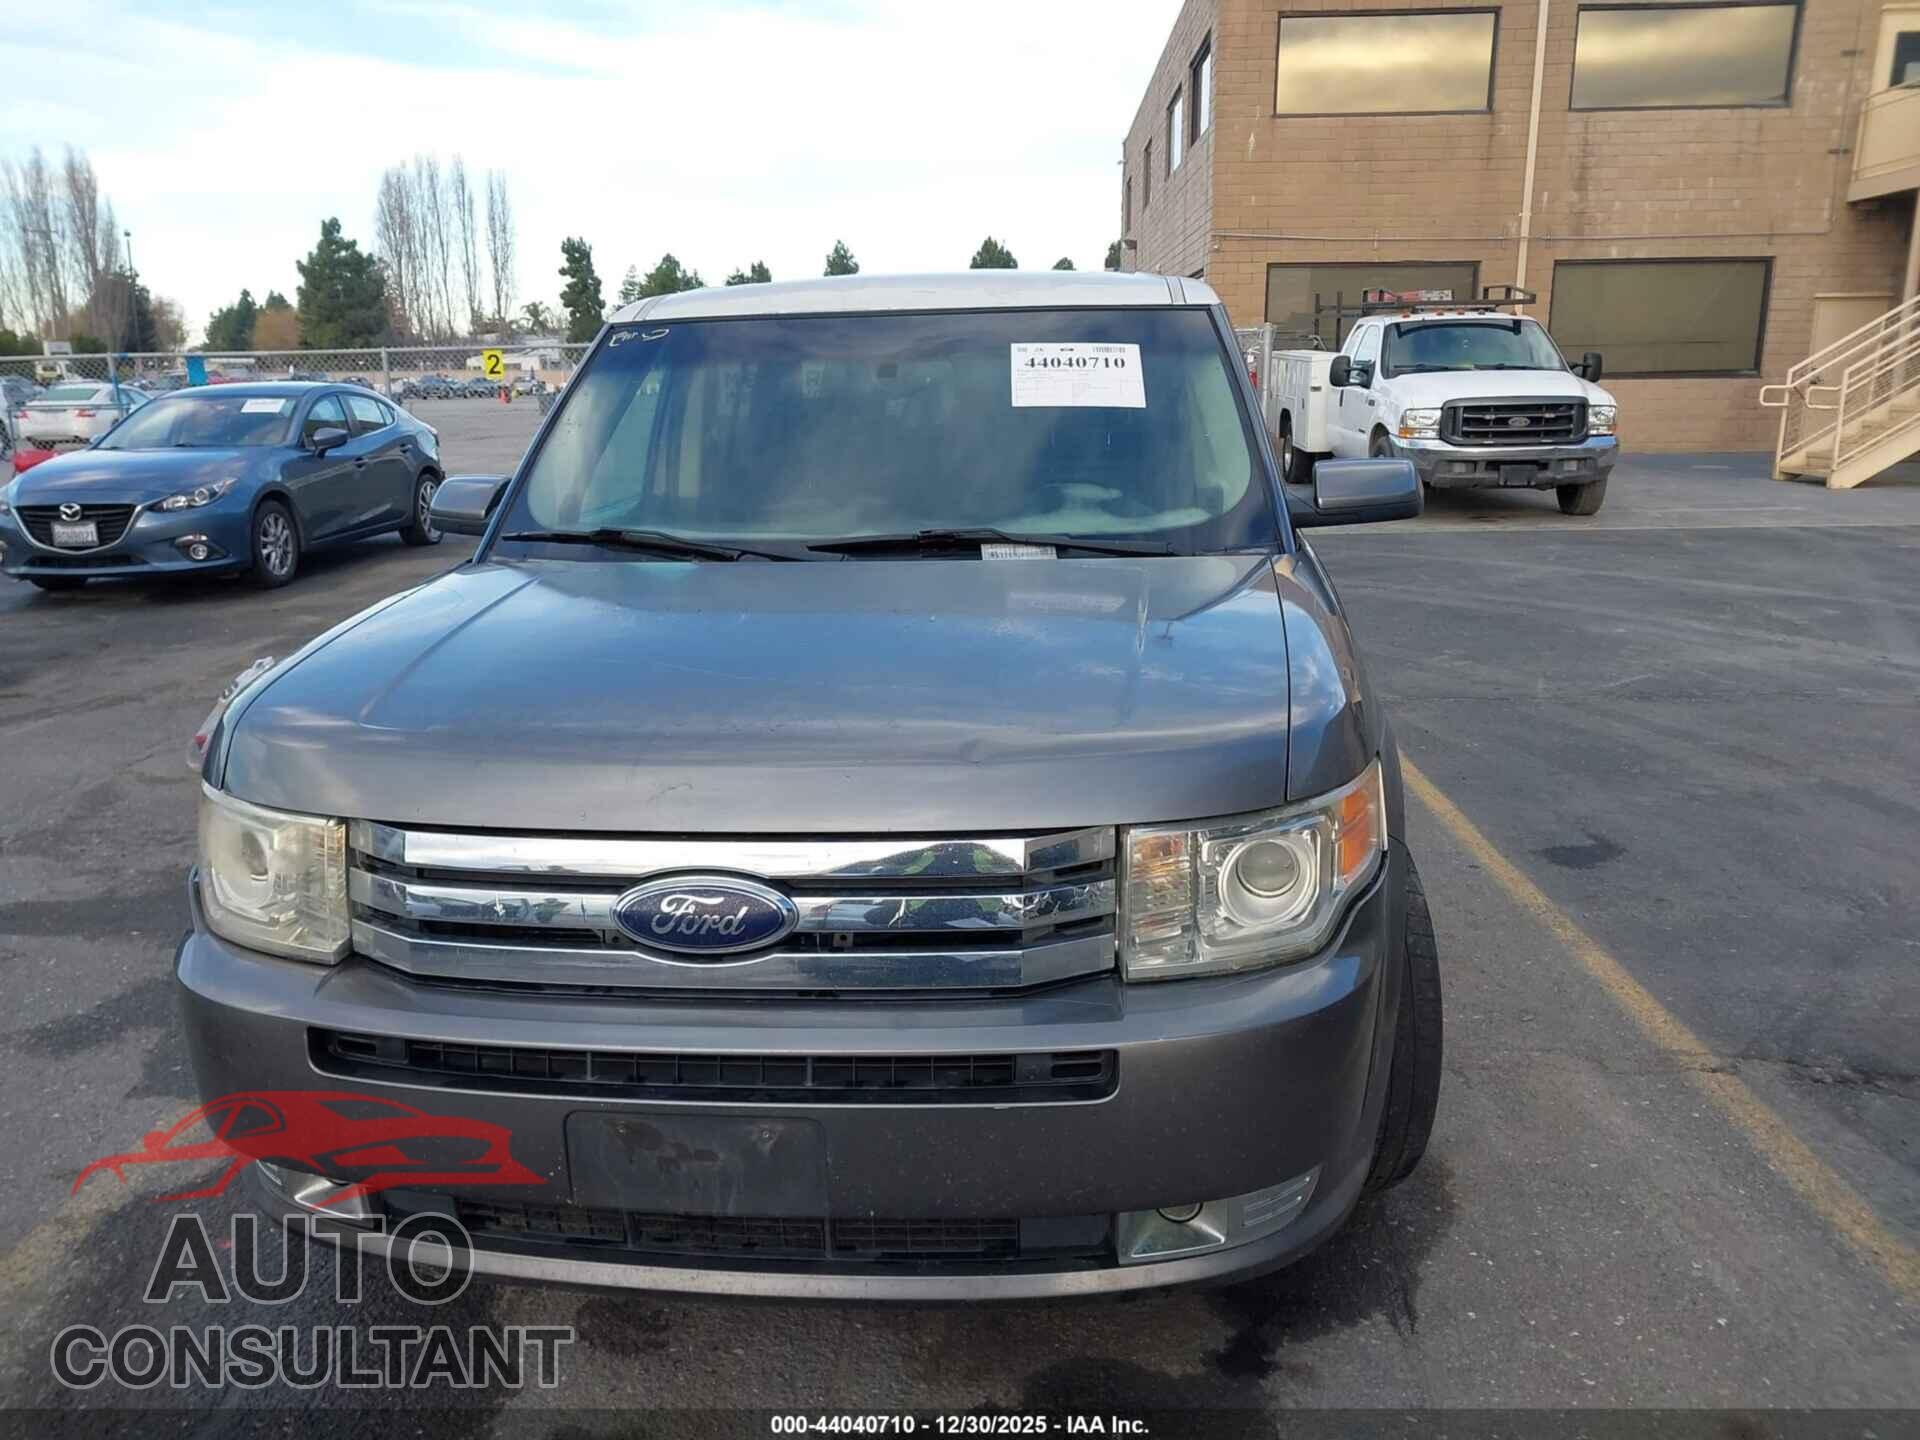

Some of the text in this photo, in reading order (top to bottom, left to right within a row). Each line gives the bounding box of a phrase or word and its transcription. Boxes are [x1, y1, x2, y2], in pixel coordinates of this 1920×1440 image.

[487, 354, 502, 375] 2
[1024, 357, 1126, 369] 44040710
[651, 894, 749, 935] Ford
